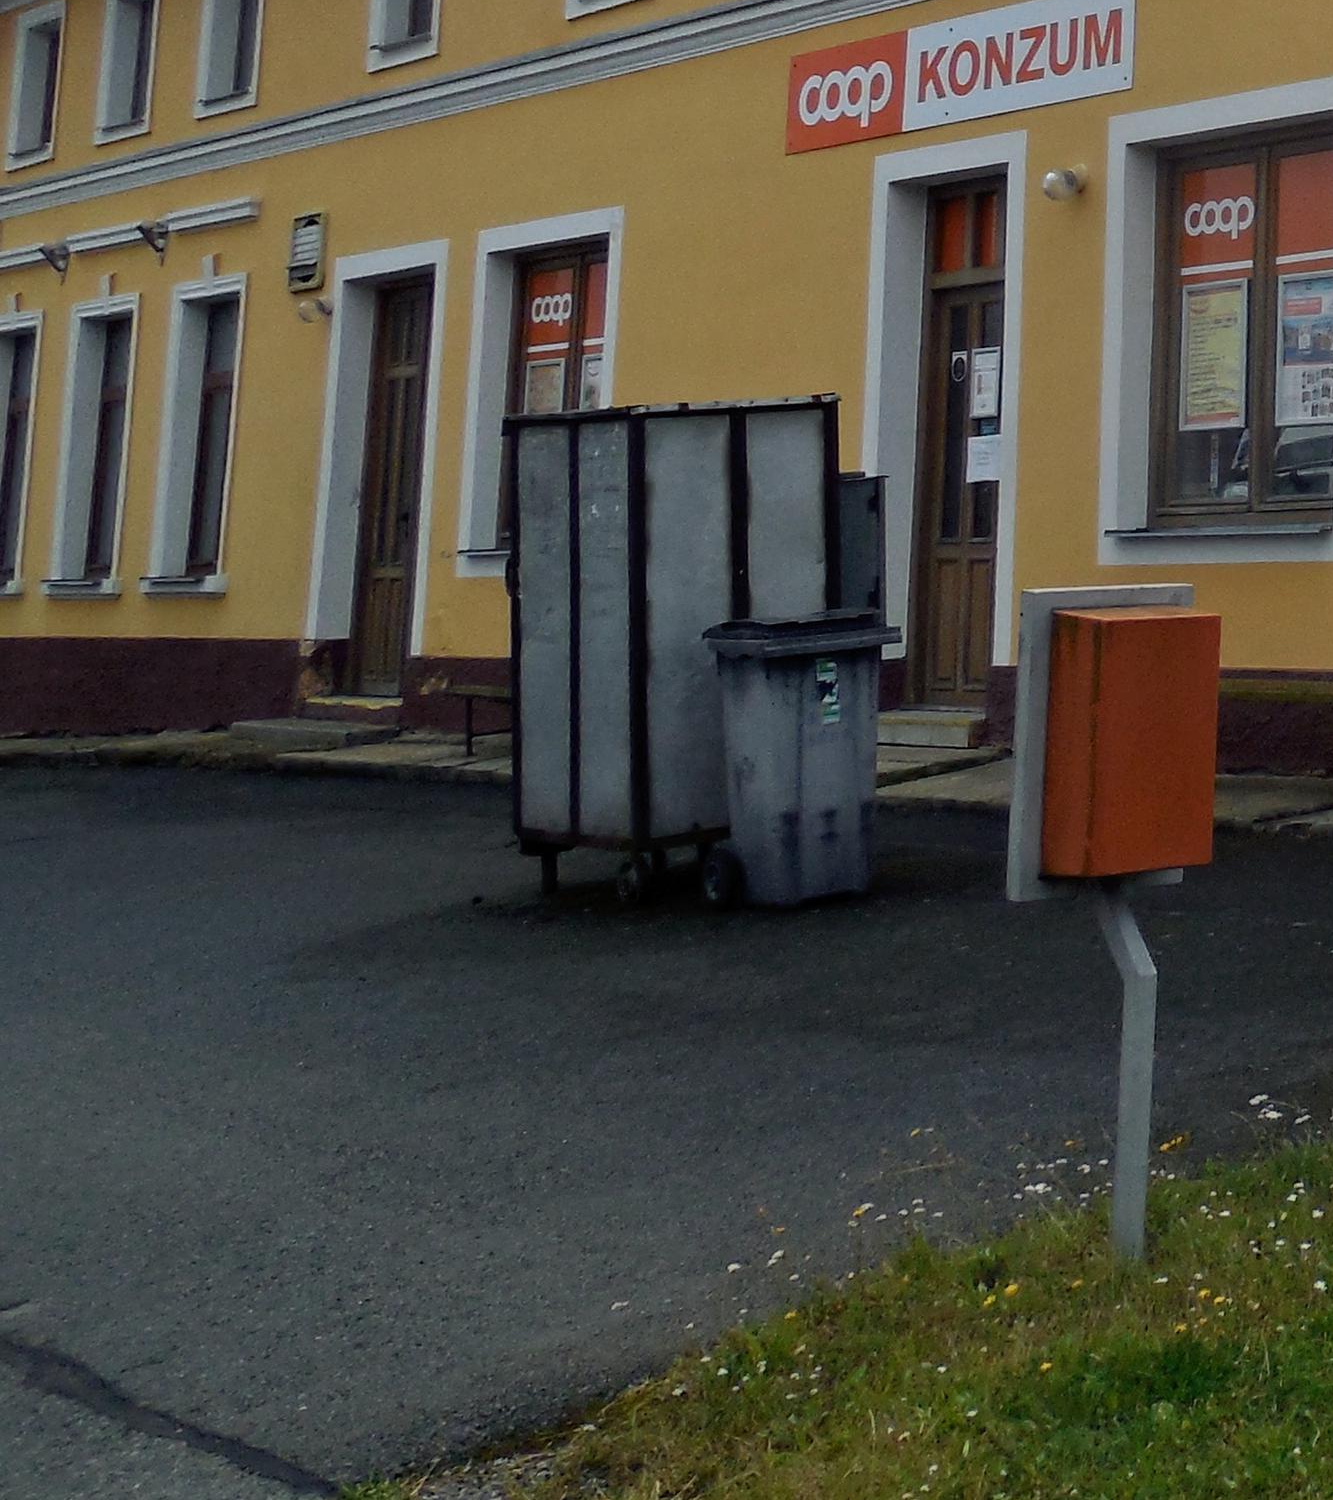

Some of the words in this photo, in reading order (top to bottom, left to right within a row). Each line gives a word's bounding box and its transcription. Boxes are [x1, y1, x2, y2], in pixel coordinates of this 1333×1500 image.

[799, 60, 893, 128] coop
[917, 8, 1123, 103] KONZUM
[1184, 195, 1255, 240] coop
[531, 292, 572, 326] coop
